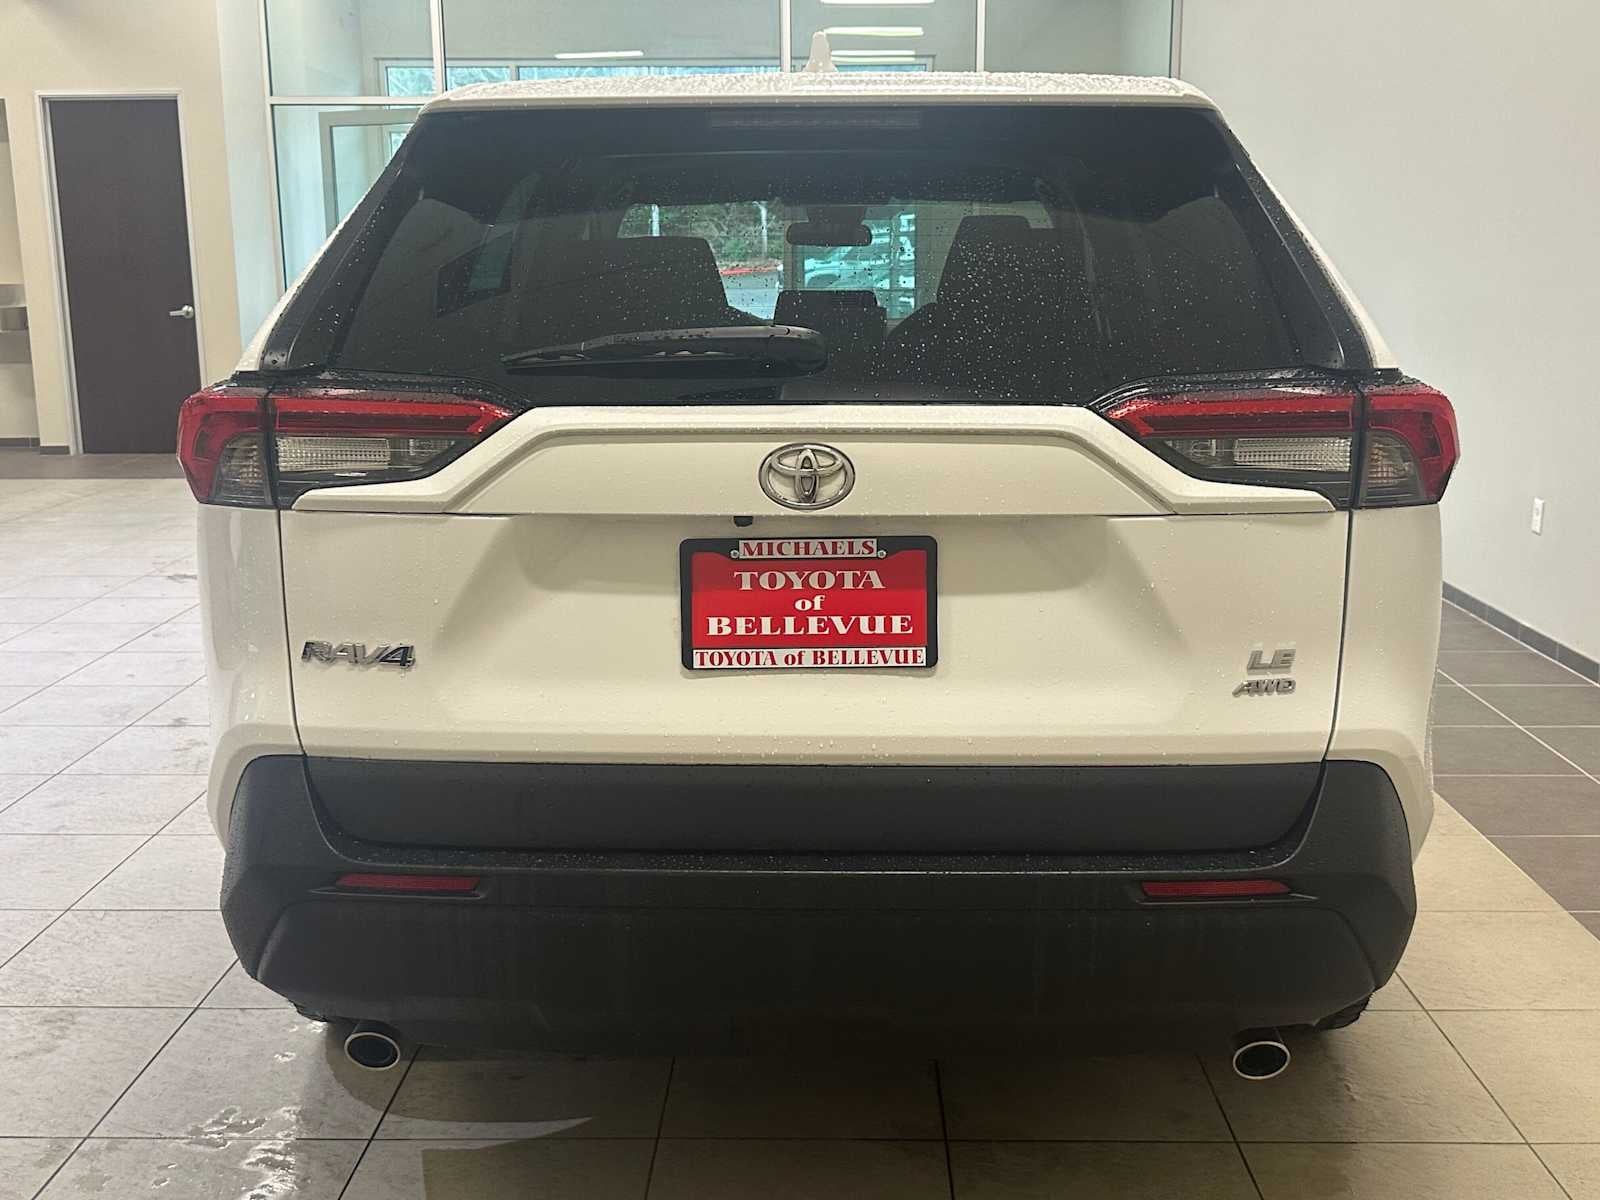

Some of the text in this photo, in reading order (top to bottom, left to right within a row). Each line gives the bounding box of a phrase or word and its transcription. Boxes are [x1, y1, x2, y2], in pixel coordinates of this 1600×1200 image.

[742, 540, 875, 557] MICHAELS
[733, 570, 886, 591] TOYOTA
[794, 595, 826, 611] of
[706, 614, 914, 636] BELLEVUE
[301, 641, 416, 668] RAV4
[695, 649, 925, 667] TOYOTA of BELLEVUE
[1247, 648, 1296, 675] LE
[1232, 678, 1296, 698] AWD
